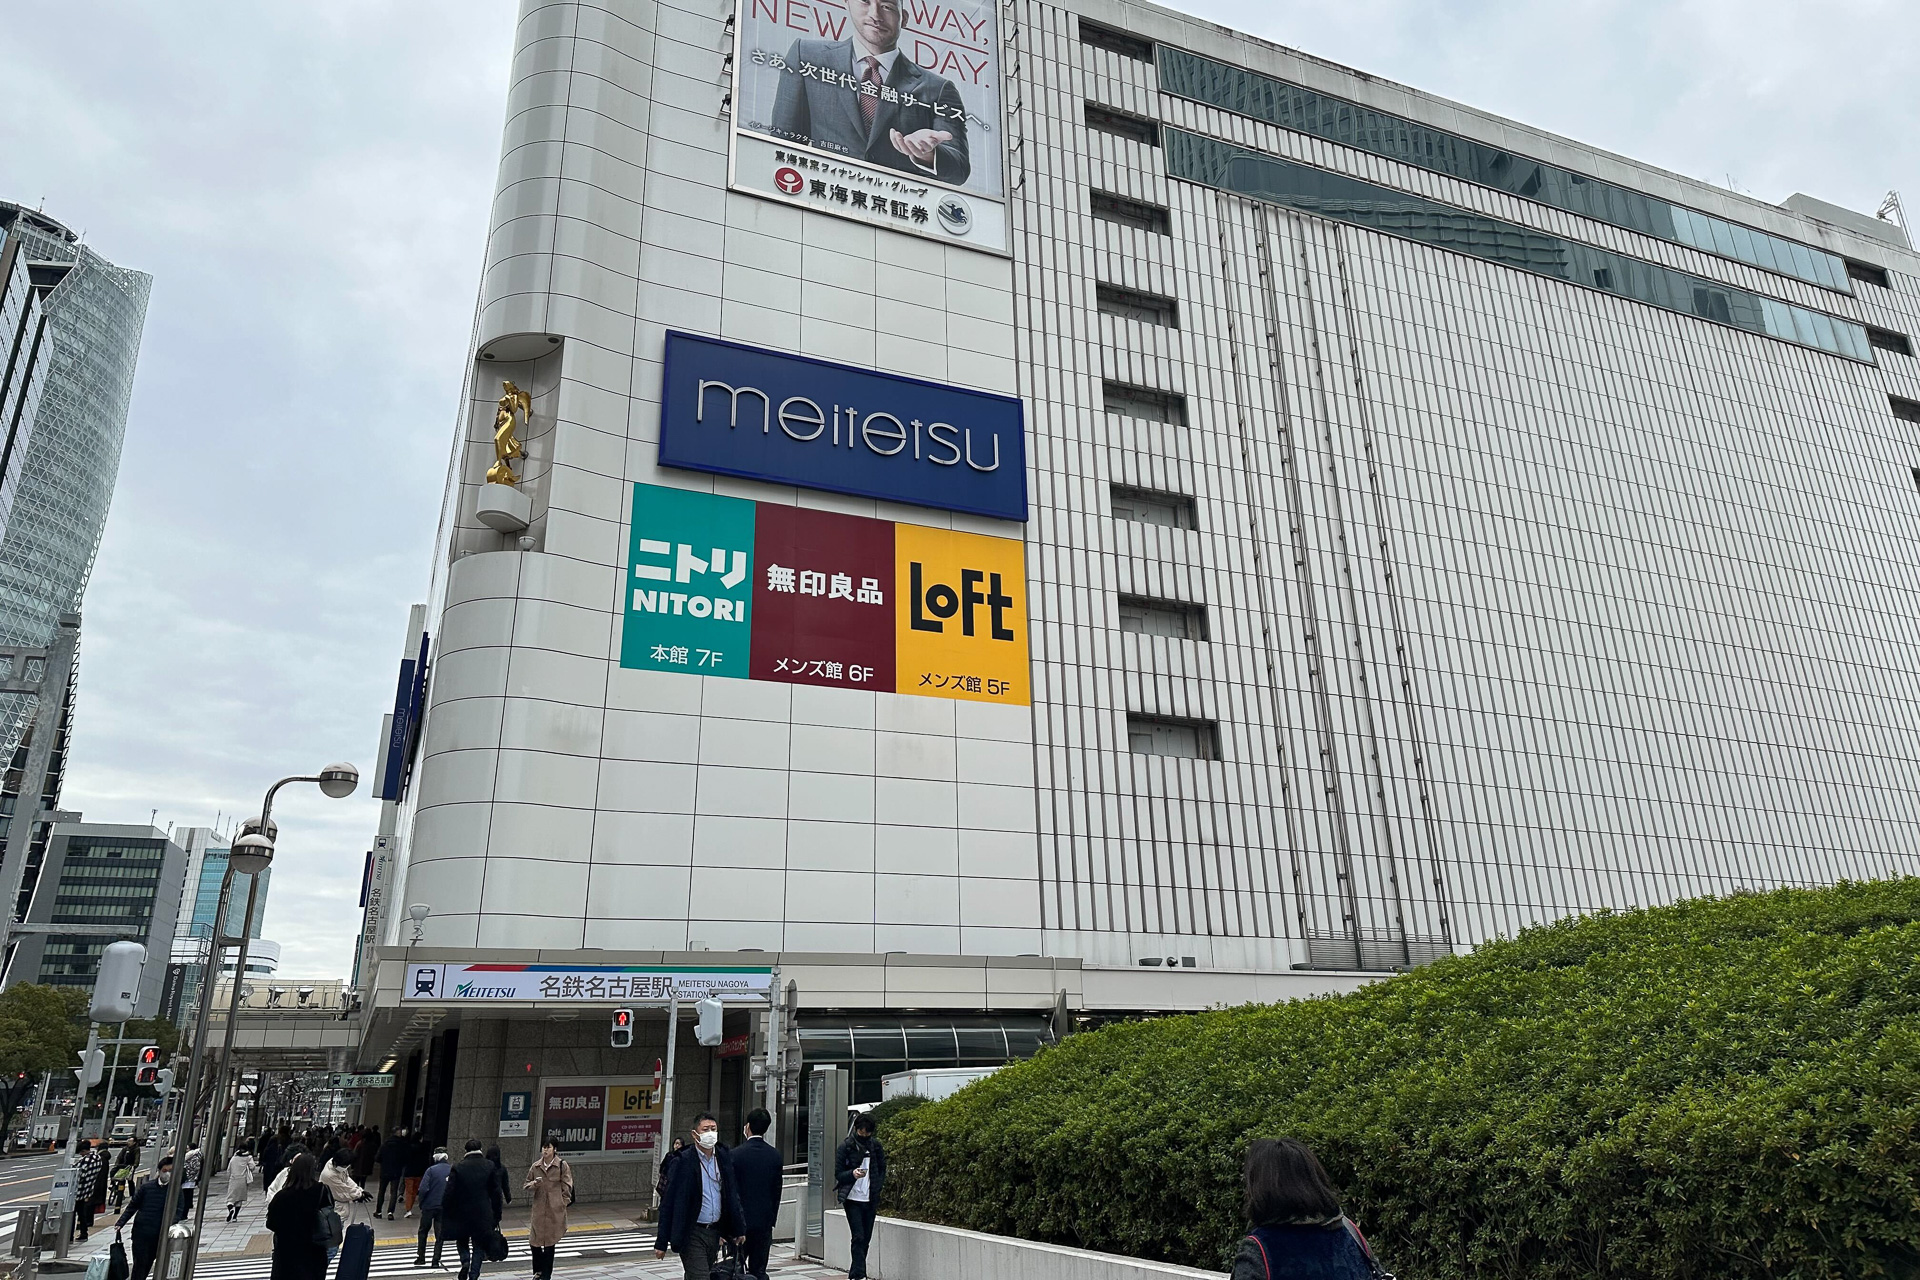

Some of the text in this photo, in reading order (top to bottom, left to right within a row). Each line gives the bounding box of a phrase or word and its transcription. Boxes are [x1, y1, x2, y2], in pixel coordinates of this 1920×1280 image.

[909, 0, 989, 45] WAY,
[752, 0, 990, 89] NEW DAY.
[751, 49, 991, 131] さあ、次世代金融サービスへ。
[809, 178, 929, 223] 東海東京証券
[697, 379, 1000, 472] meitetsu
[635, 538, 747, 590] ニトリ
[767, 563, 883, 606] 無印良品
[632, 589, 745, 622] NITORI
[650, 643, 724, 668] 本館 7F
[773, 657, 875, 683] メンズ館 6F
[918, 672, 1010, 695] メンズ館 5F
[453, 980, 516, 998] MEITETSU
[539, 975, 673, 999] 名鉄名古屋駅
[677, 990, 709, 999] STATION
[679, 980, 749, 988] MEITETSU NAGOYA
[549, 1096, 600, 1109] 無印良品
[566, 1128, 596, 1141] MUJI
